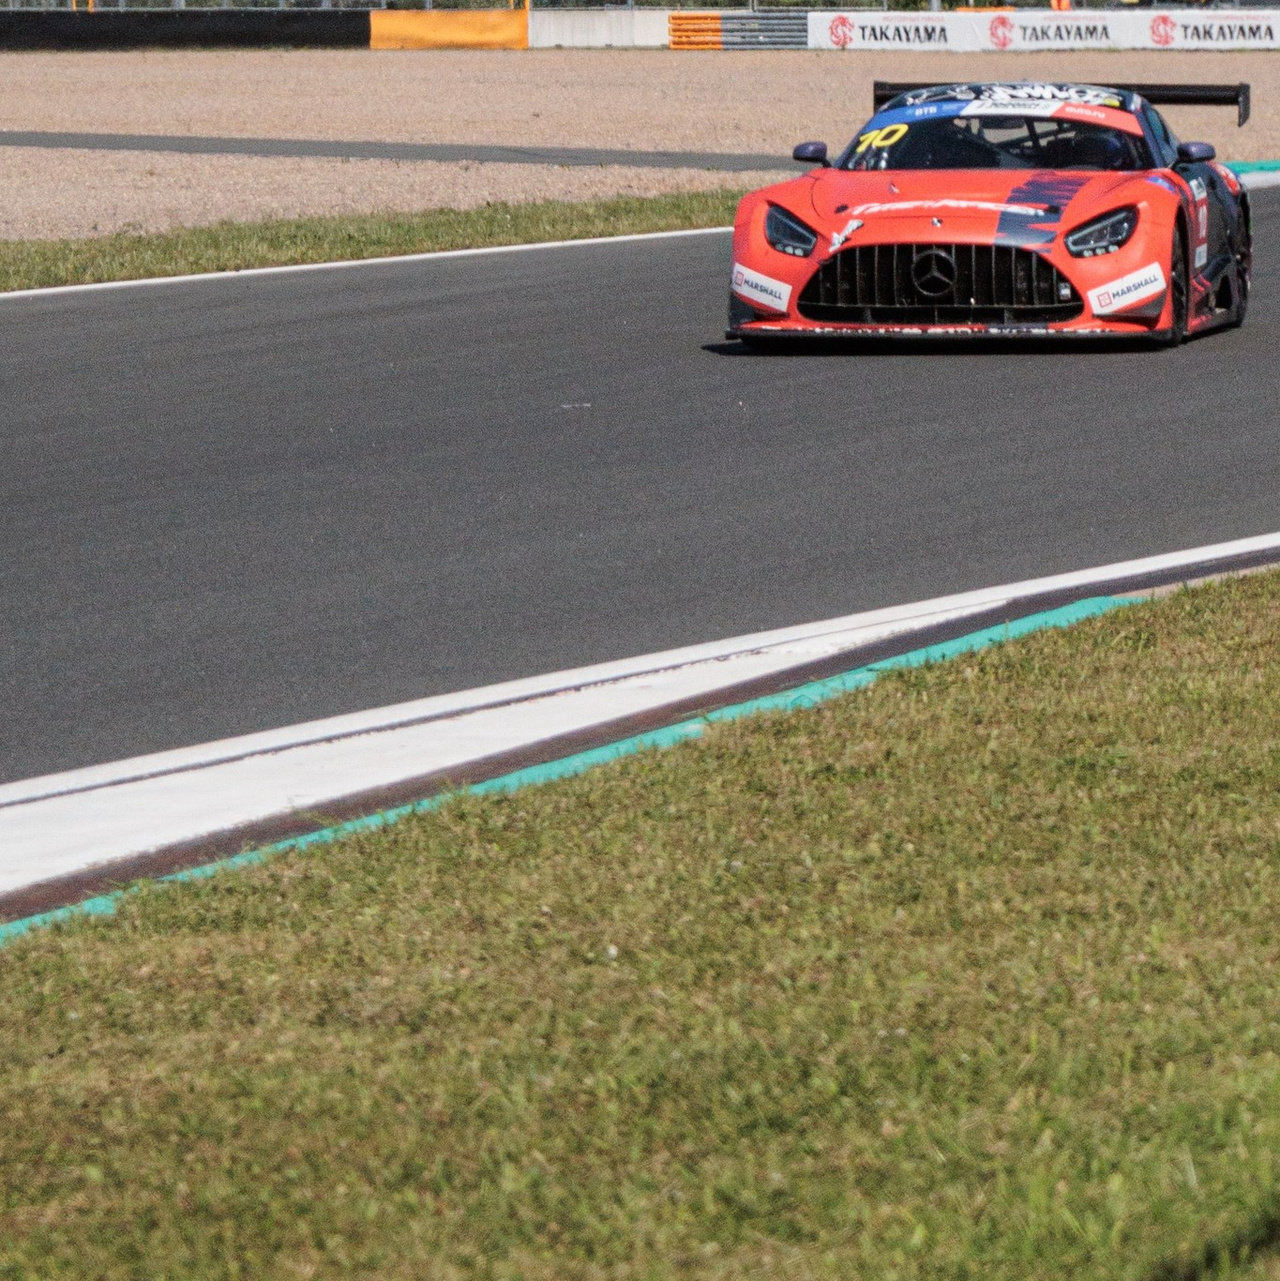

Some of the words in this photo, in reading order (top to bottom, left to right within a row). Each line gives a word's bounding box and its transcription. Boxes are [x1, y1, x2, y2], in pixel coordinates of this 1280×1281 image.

[859, 25, 947, 43] TAKAYAMA
[1020, 24, 1110, 41] TAKAYAMA
[1181, 24, 1274, 41] TAKAYAMA
[856, 123, 909, 153] 10
[743, 273, 783, 301] MARSHALL
[1111, 274, 1159, 300] MARSHALL
